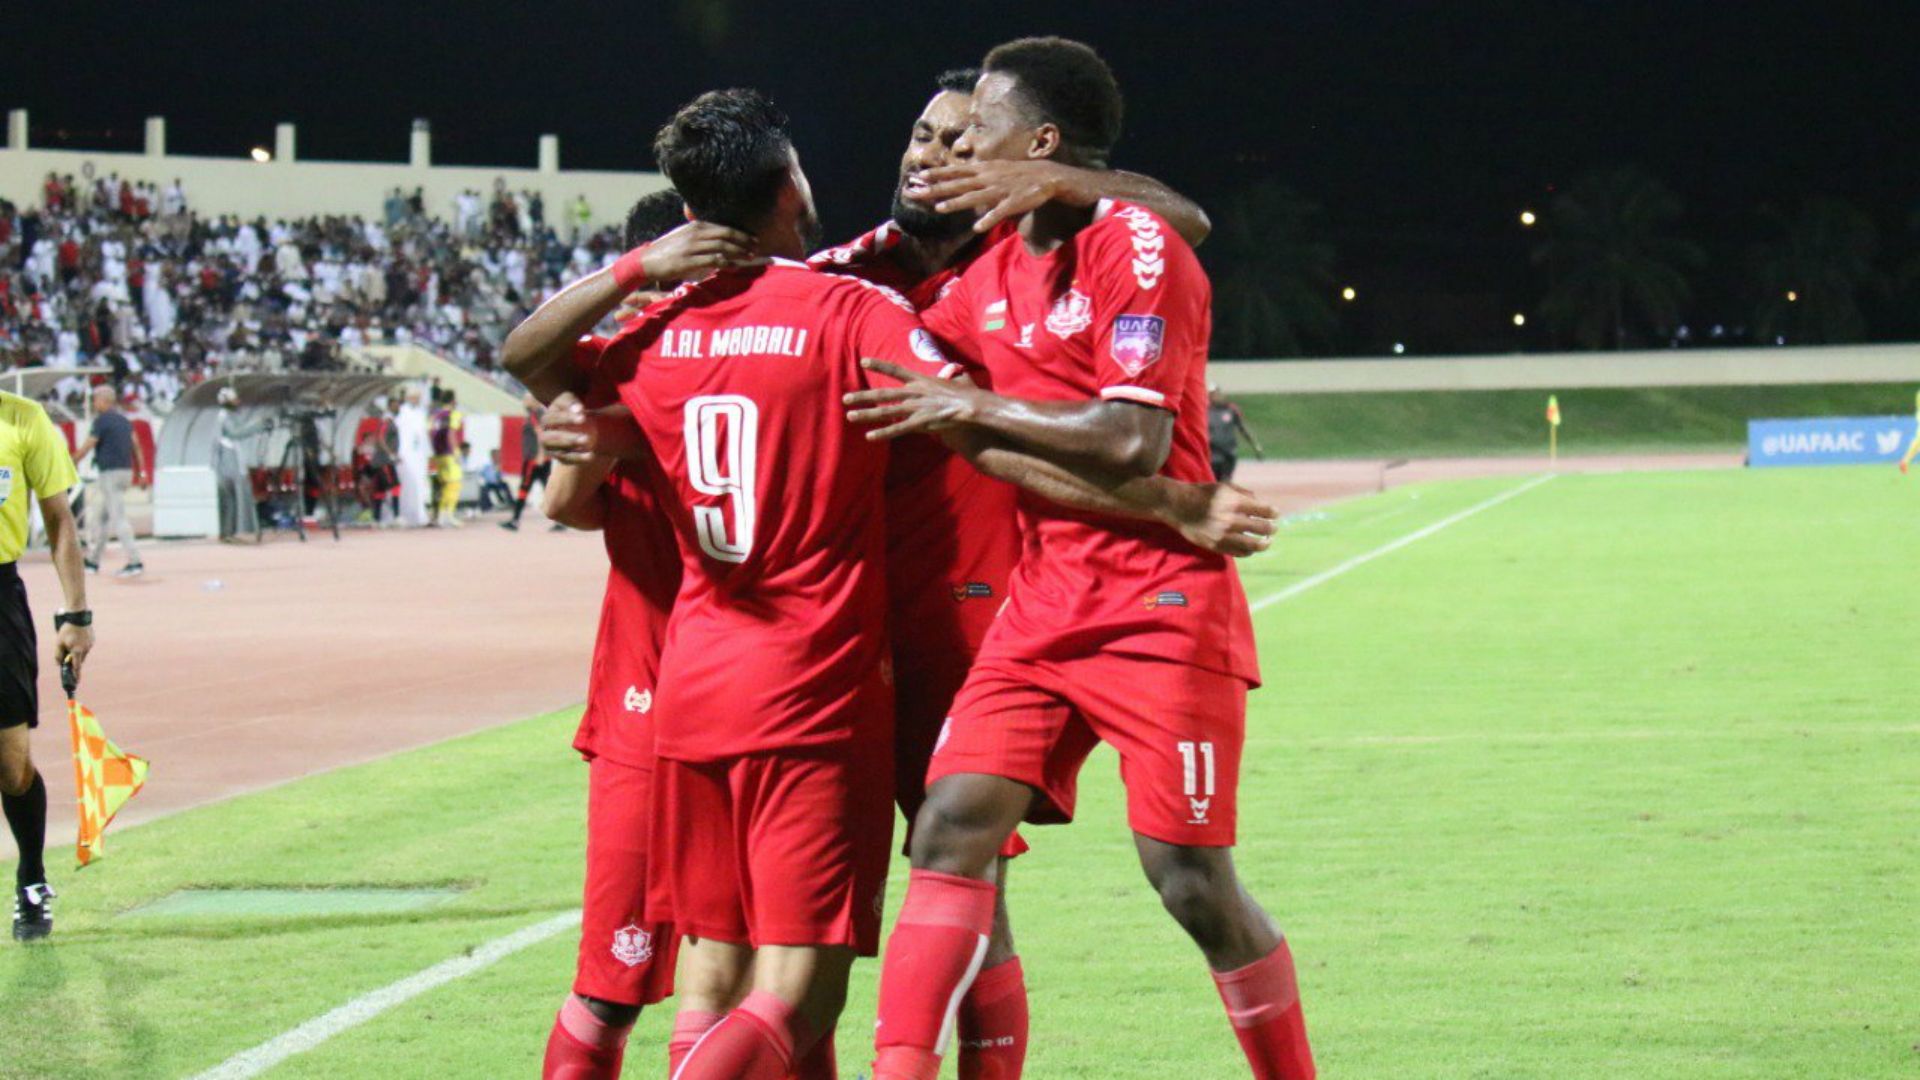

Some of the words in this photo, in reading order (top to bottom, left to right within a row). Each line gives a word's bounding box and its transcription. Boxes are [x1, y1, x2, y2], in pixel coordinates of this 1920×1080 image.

[1119, 319, 1160, 332] UAFA
[1762, 431, 1865, 456] @UAFAAC
[683, 394, 759, 564] 9
[1177, 741, 1215, 795] 11
